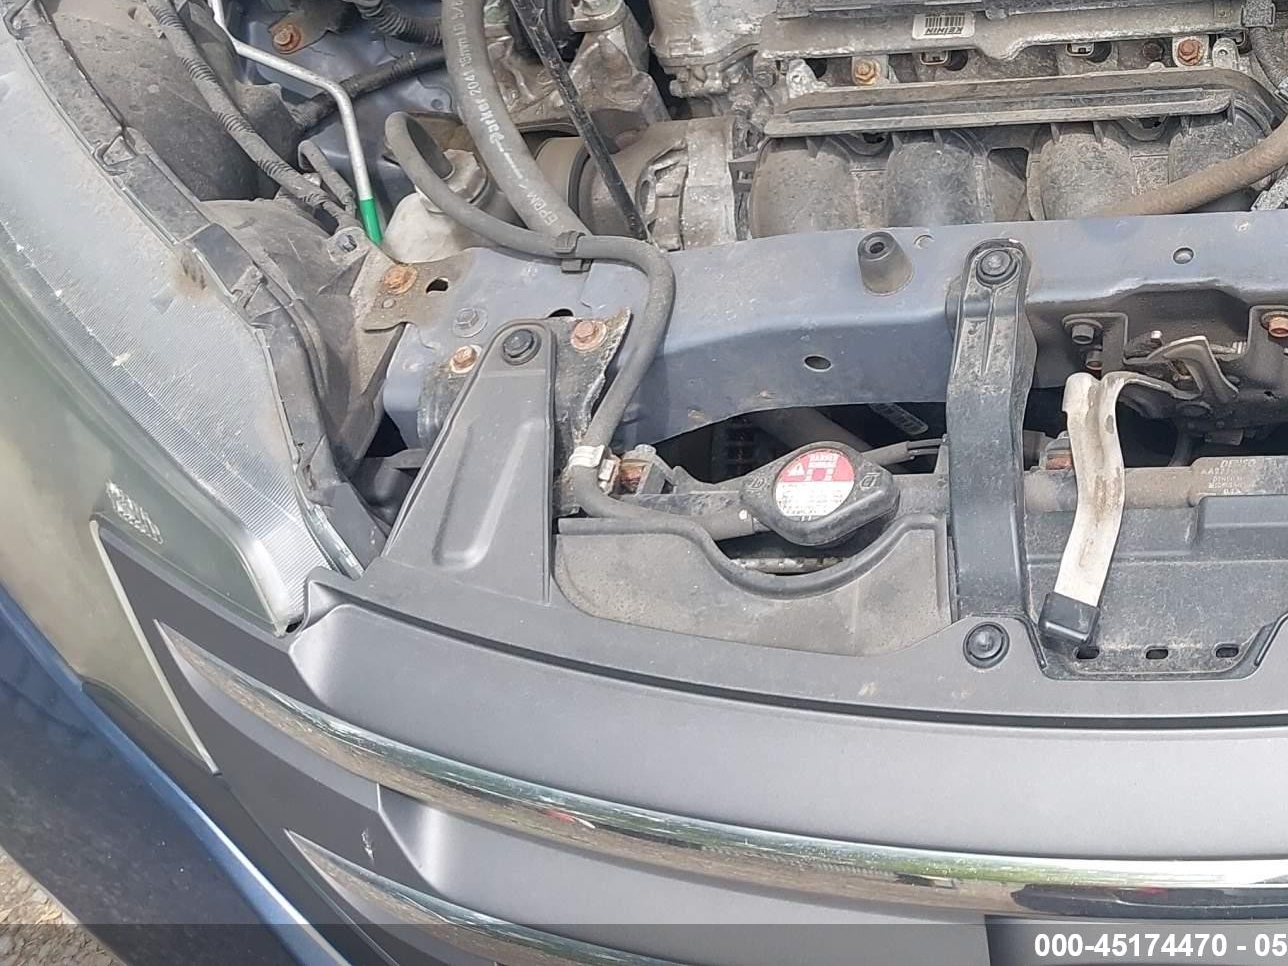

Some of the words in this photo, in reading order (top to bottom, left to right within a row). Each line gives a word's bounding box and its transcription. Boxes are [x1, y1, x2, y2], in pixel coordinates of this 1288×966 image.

[464, 70, 481, 96] 2041
[477, 97, 505, 144] Parker
[526, 191, 559, 226] EPDM
